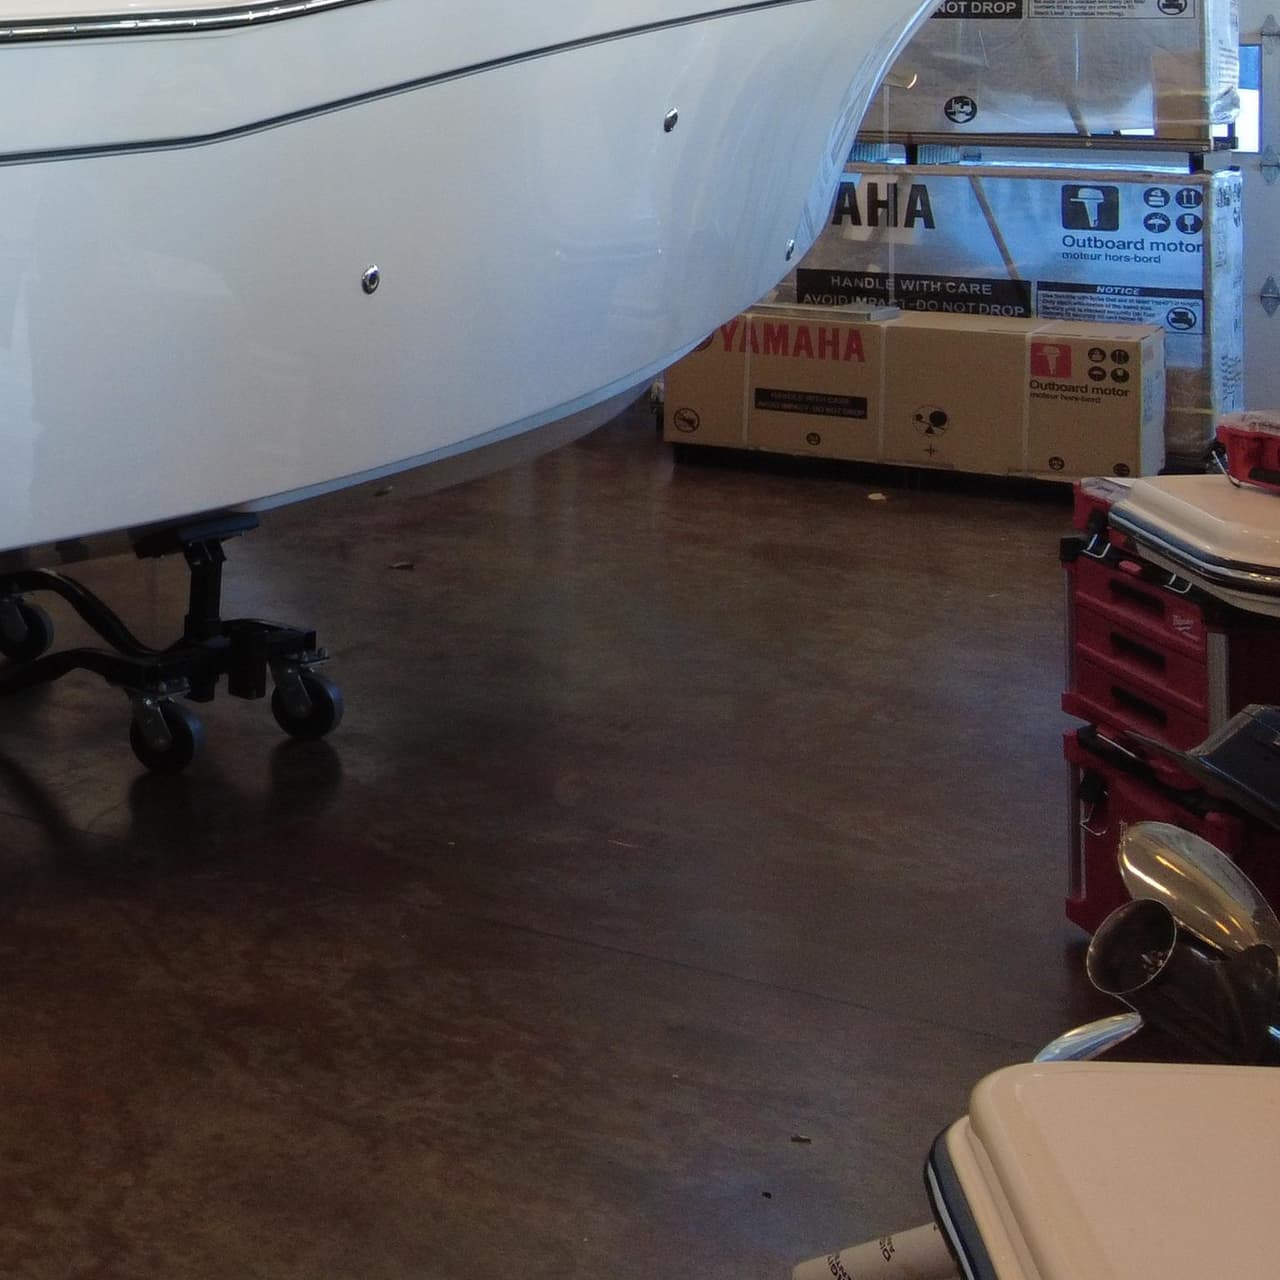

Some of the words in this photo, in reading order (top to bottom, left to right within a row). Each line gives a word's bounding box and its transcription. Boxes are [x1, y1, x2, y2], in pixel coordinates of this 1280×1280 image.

[972, 1, 1016, 13] DROP
[1062, 235, 1144, 251] Outboard
[1150, 240, 1203, 253] motor
[1062, 252, 1102, 261] moteur
[1105, 254, 1161, 264] hors-bord
[831, 275, 895, 291] HANDLE
[900, 278, 941, 293] WITH
[946, 281, 992, 296] CARE
[1096, 285, 1139, 295] NOTICE
[803, 293, 848, 306] AVOID
[943, 299, 976, 314] NOT
[978, 302, 1025, 317] DROP
[720, 317, 865, 362] YAMAHA
[1030, 380, 1088, 393] Outboard
[1092, 385, 1130, 397] motor
